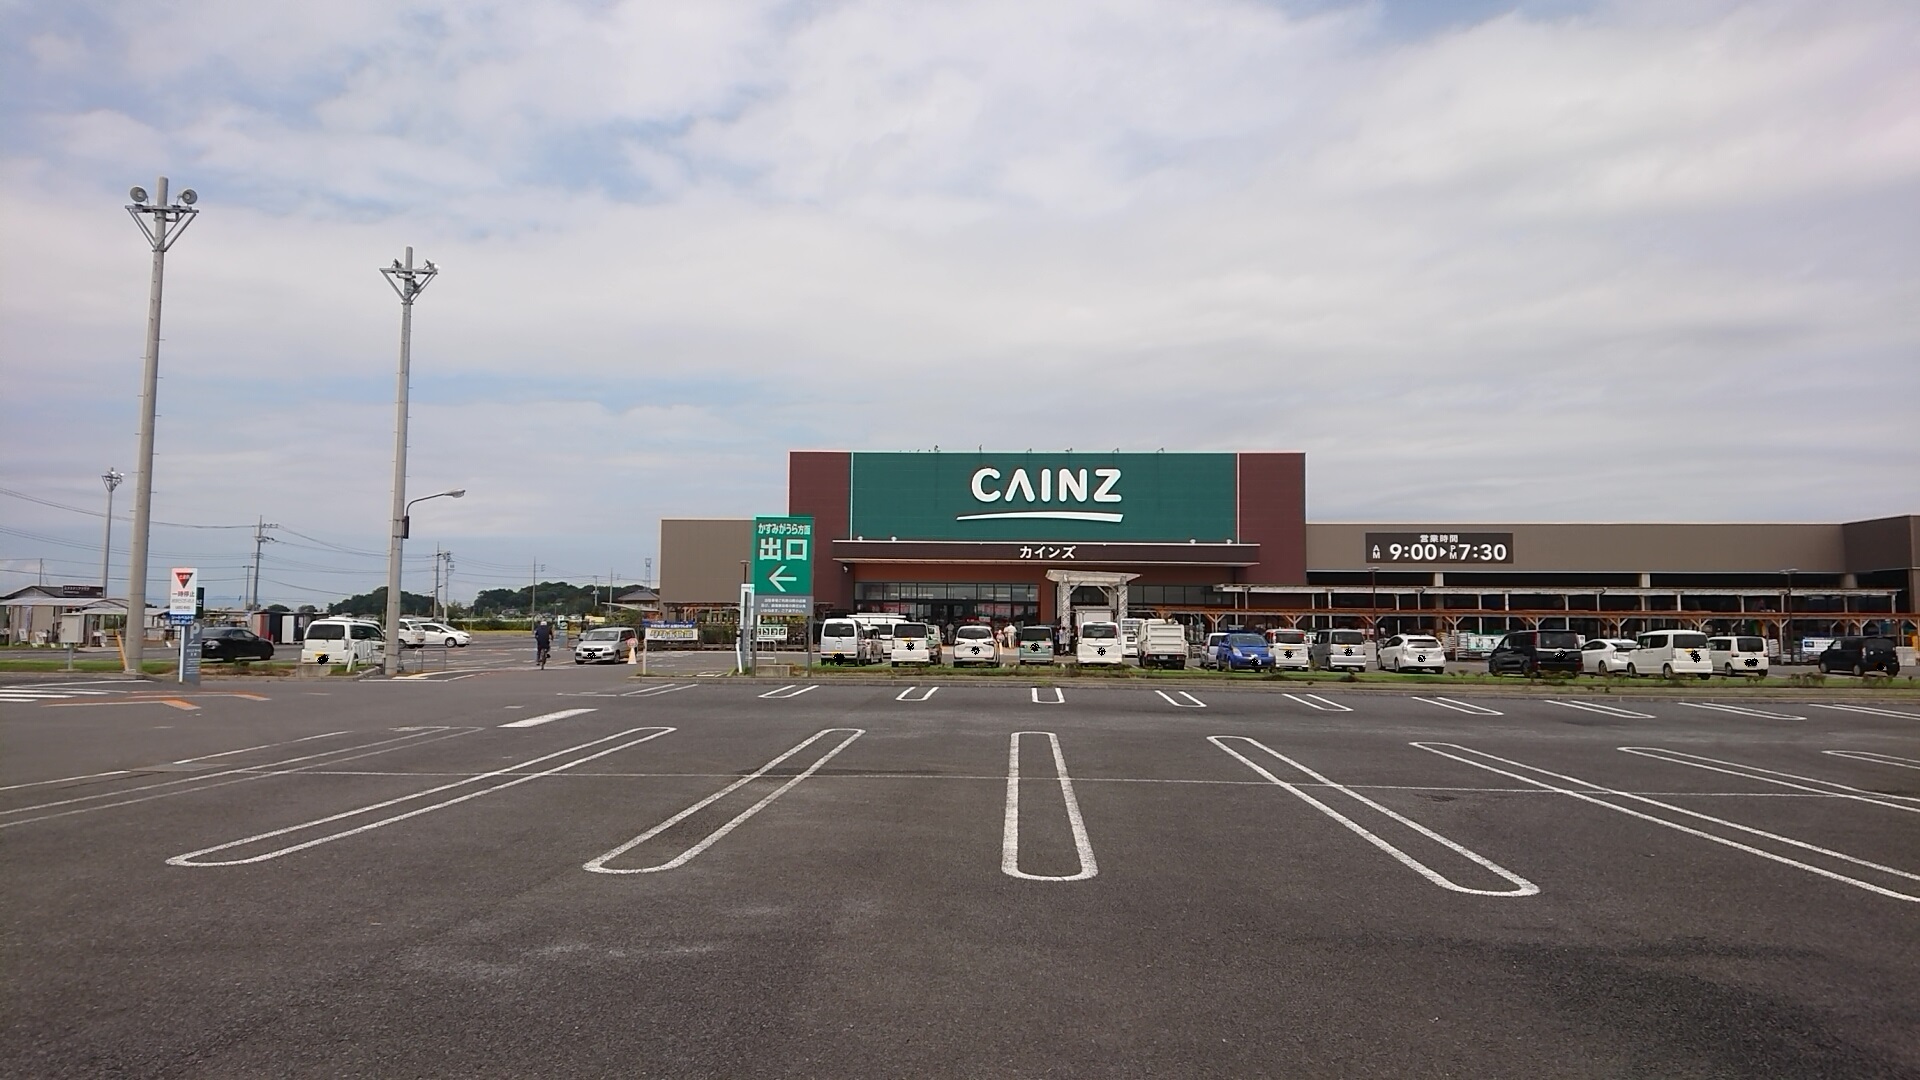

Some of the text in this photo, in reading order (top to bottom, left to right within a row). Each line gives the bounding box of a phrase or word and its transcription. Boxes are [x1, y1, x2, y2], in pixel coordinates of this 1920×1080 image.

[971, 468, 1122, 502] CAINZ
[758, 523, 811, 535] かすみがうら方面
[1420, 535, 1458, 543] 営業時間
[759, 537, 807, 560] 出口
[1019, 546, 1077, 559] カインズ
[1389, 544, 1437, 560] 9:00
[1459, 544, 1507, 560] 7:30
[190, 623, 200, 639] P
